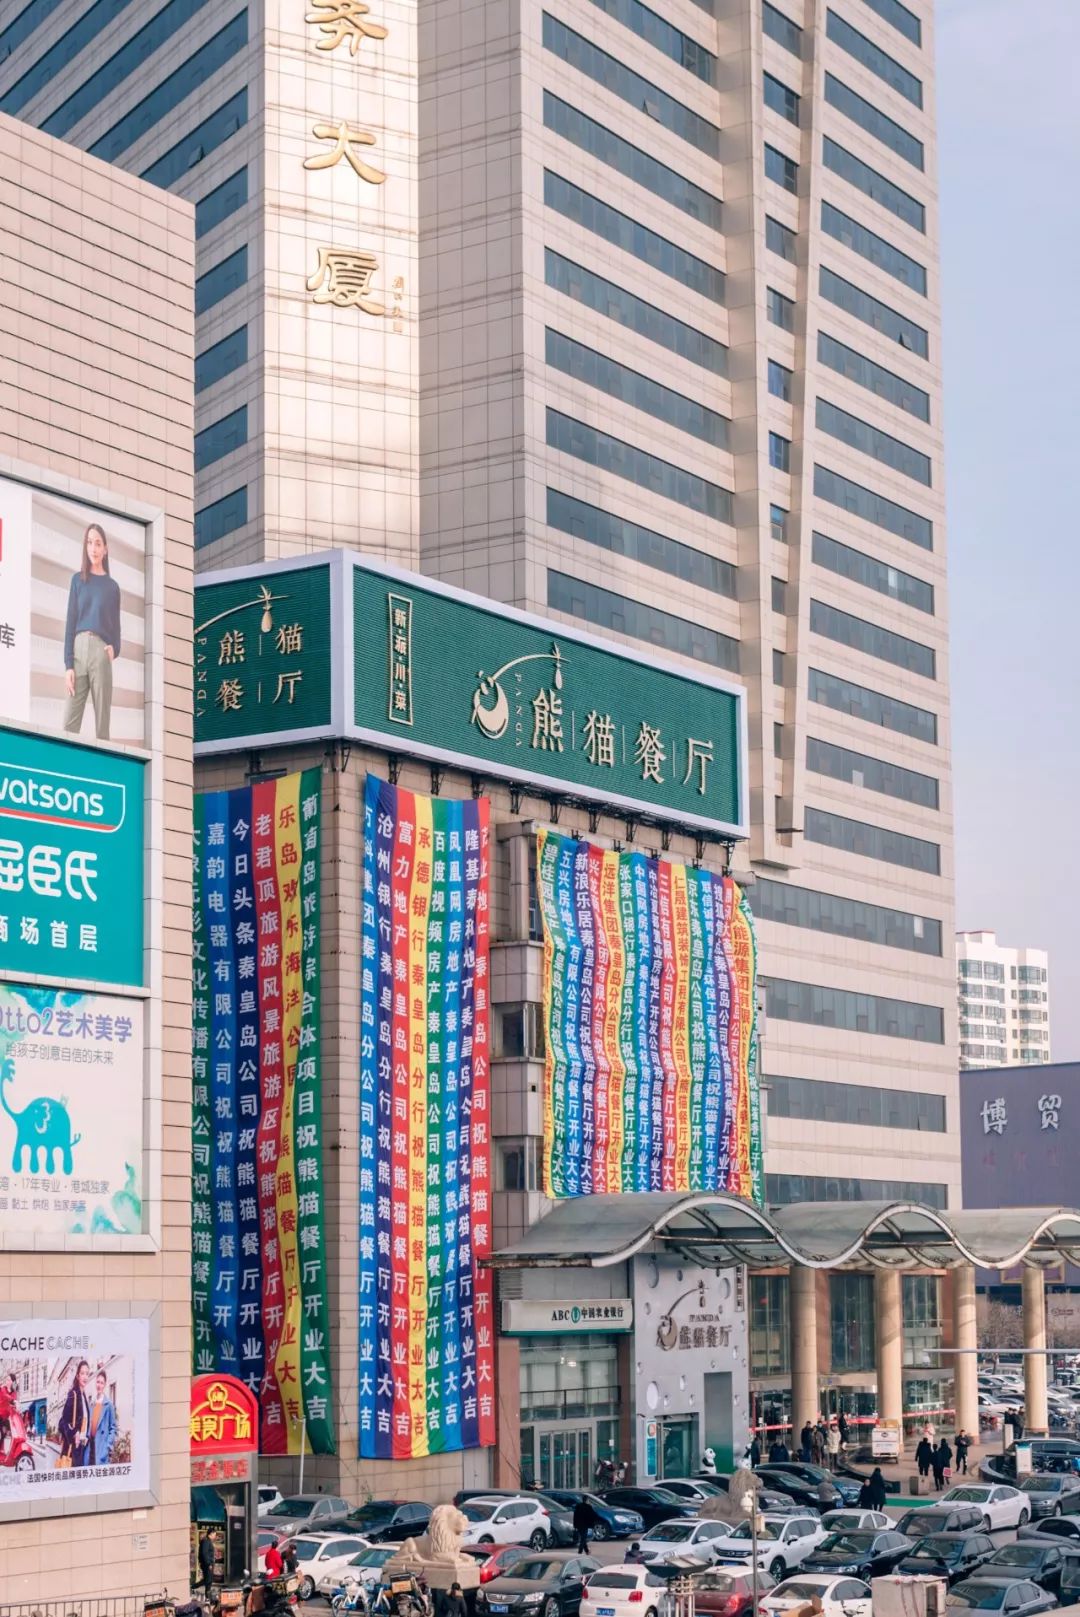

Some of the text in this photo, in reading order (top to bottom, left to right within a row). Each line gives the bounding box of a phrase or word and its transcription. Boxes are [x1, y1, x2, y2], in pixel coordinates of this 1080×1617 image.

[218, 622, 304, 666] 熊猫
[214, 669, 303, 713] 餐厅
[530, 686, 715, 797] 熊猫餐厅
[0, 1007, 132, 1044] tto2艺术美学
[551, 1310, 570, 1321] ABC
[581, 1306, 624, 1319] 中国农业银行
[1, 1337, 45, 1351] CACHE
